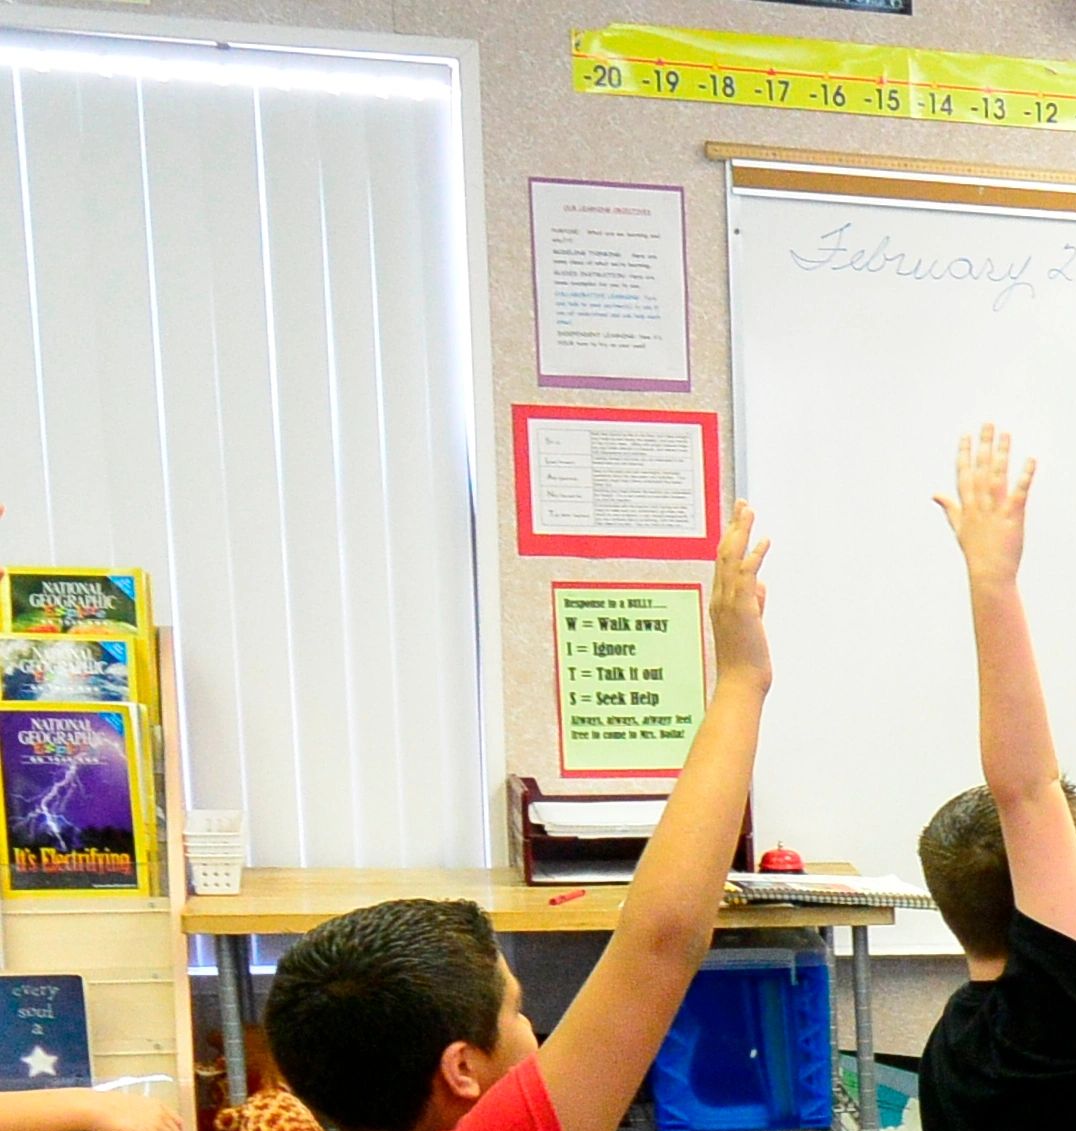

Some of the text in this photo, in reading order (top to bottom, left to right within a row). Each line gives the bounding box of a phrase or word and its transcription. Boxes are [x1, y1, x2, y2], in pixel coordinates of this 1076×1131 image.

[584, 64, 622, 88] -20
[642, 69, 679, 93] -19
[698, 74, 735, 97] -18
[754, 79, 789, 101] -17
[809, 84, 846, 107] -16
[864, 89, 900, 111] -15
[918, 93, 952, 116] -14
[971, 97, 1006, 120] -13
[1024, 101, 1058, 123] -12
[789, 222, 1035, 312] February
[42, 581, 101, 594] NATIONAL
[29, 593, 117, 609] GEOGRAPHIC
[565, 617, 578, 631] W
[597, 616, 631, 631] Walk
[635, 619, 668, 633] away
[566, 641, 572, 656] I
[592, 641, 636, 658] Ignore
[568, 667, 577, 681] T
[595, 666, 626, 681] Talk
[629, 666, 639, 681] it
[642, 667, 663, 680] out
[569, 691, 577, 705] S
[595, 691, 627, 705] Seek
[630, 691, 660, 707] Help
[30, 718, 92, 732] NATIONAL
[13, 847, 132, 875] It's Electrifying
